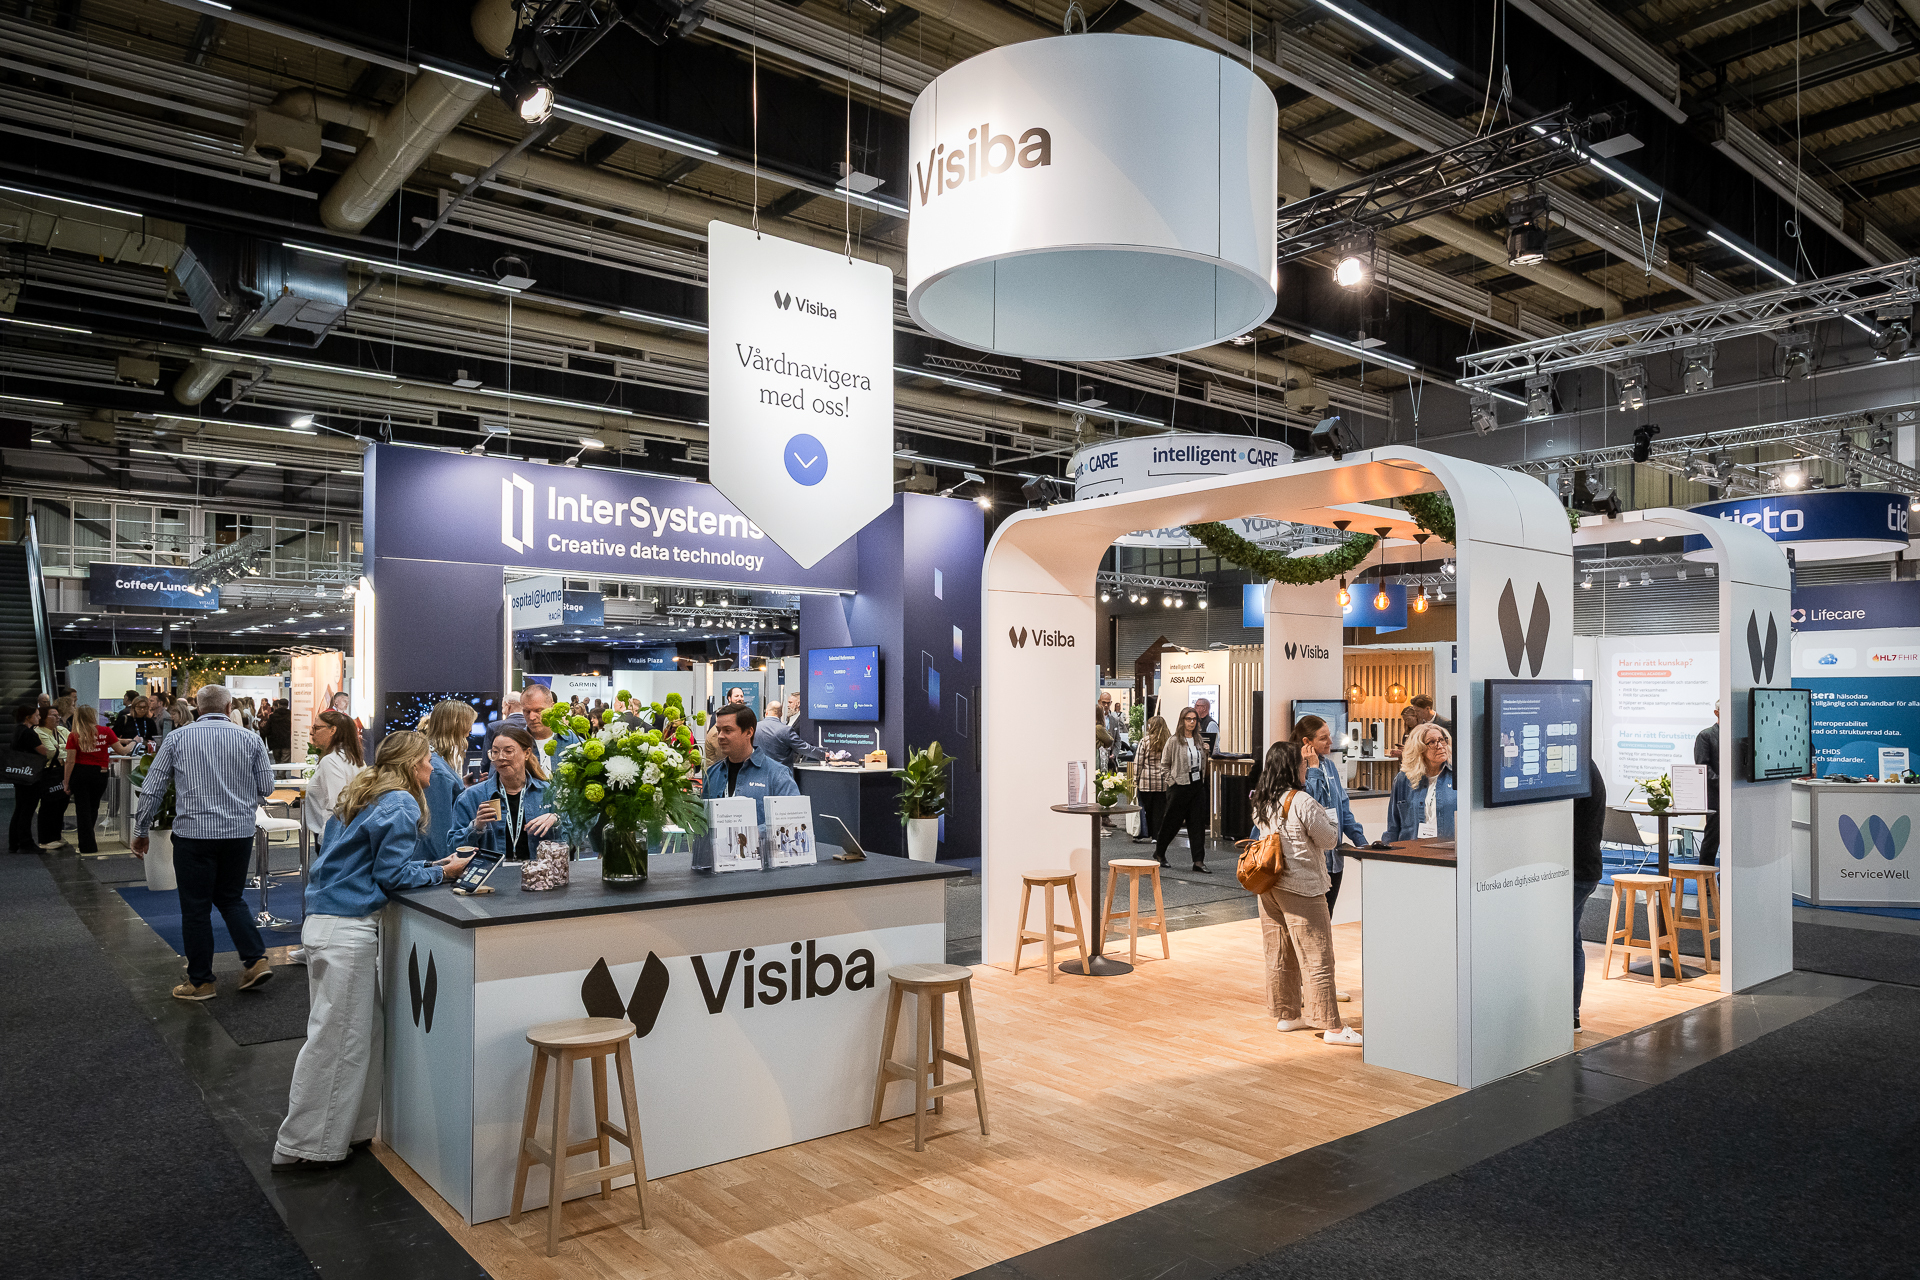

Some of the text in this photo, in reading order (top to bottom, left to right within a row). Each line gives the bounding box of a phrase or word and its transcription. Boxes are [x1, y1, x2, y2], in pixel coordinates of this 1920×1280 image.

[916, 122, 1052, 207] Visiba
[795, 296, 837, 320] Visiba
[736, 342, 872, 391] Vårdnavigera
[760, 388, 849, 418] med oss!
[1089, 451, 1119, 472] CARE
[1153, 446, 1279, 467] intelligent CARE
[548, 486, 765, 540] InterSystems
[547, 534, 764, 571] Creative data technology
[115, 579, 189, 592] Coffee/Lunc
[511, 589, 562, 610] ospital@Home
[1811, 608, 1866, 621] Lifecare
[1031, 629, 1075, 648] Visiba
[1300, 644, 1329, 660] Visiba
[1618, 658, 1694, 668] Har ni rätt kunskap?
[1814, 720, 1868, 728] interoperabilitet
[1619, 730, 1632, 738] Har
[1643, 731, 1656, 739] rätt
[1658, 731, 1697, 740] förutsättn
[5, 765, 34, 776] amili
[49, 781, 64, 793] ami
[1476, 880, 1502, 892] Utforska
[1502, 878, 1514, 888] den
[1514, 873, 1540, 888] digifysiska
[1840, 868, 1911, 880] ServiceWell
[690, 939, 876, 1015] Visiba
